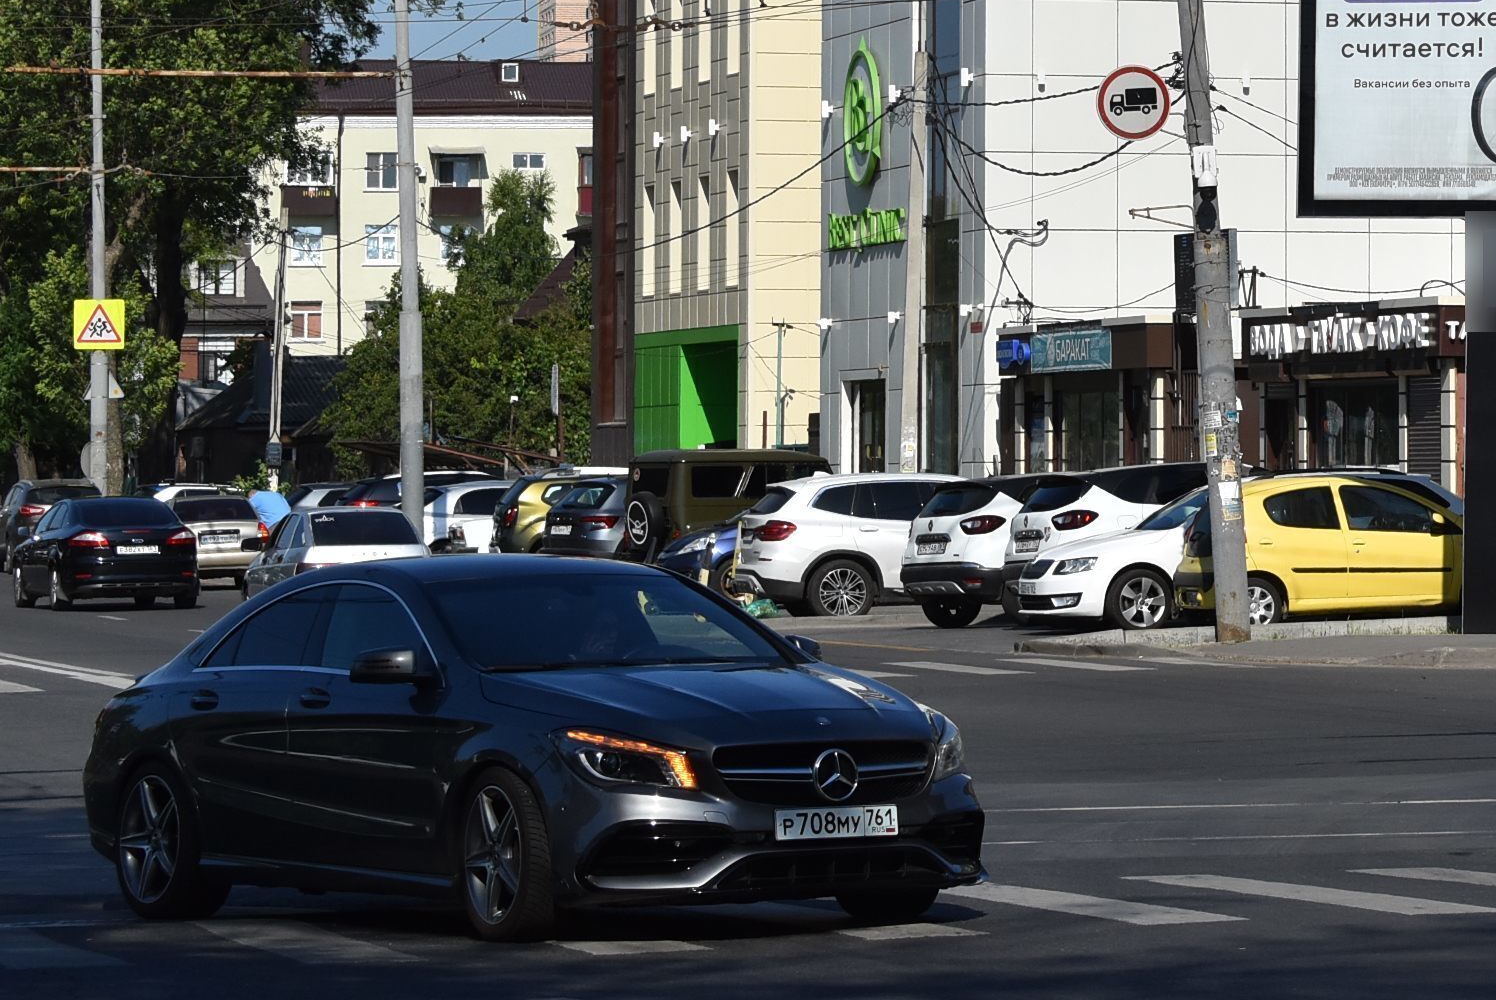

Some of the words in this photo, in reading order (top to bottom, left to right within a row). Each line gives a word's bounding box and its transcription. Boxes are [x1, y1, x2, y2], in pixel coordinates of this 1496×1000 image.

[1325, 13, 1339, 28] в
[1345, 12, 1430, 28] жизни
[1341, 37, 1484, 59] считается!
[1353, 78, 1409, 89] Вакансии
[1411, 78, 1432, 89] без
[1434, 81, 1471, 89] опыта
[1249, 323, 1295, 360] ВОДА
[1377, 313, 1431, 351] КОФЕ
[1055, 337, 1090, 362] БАРАКАТ
[782, 811, 861, 837] Р708МУ
[865, 808, 893, 827] 761
